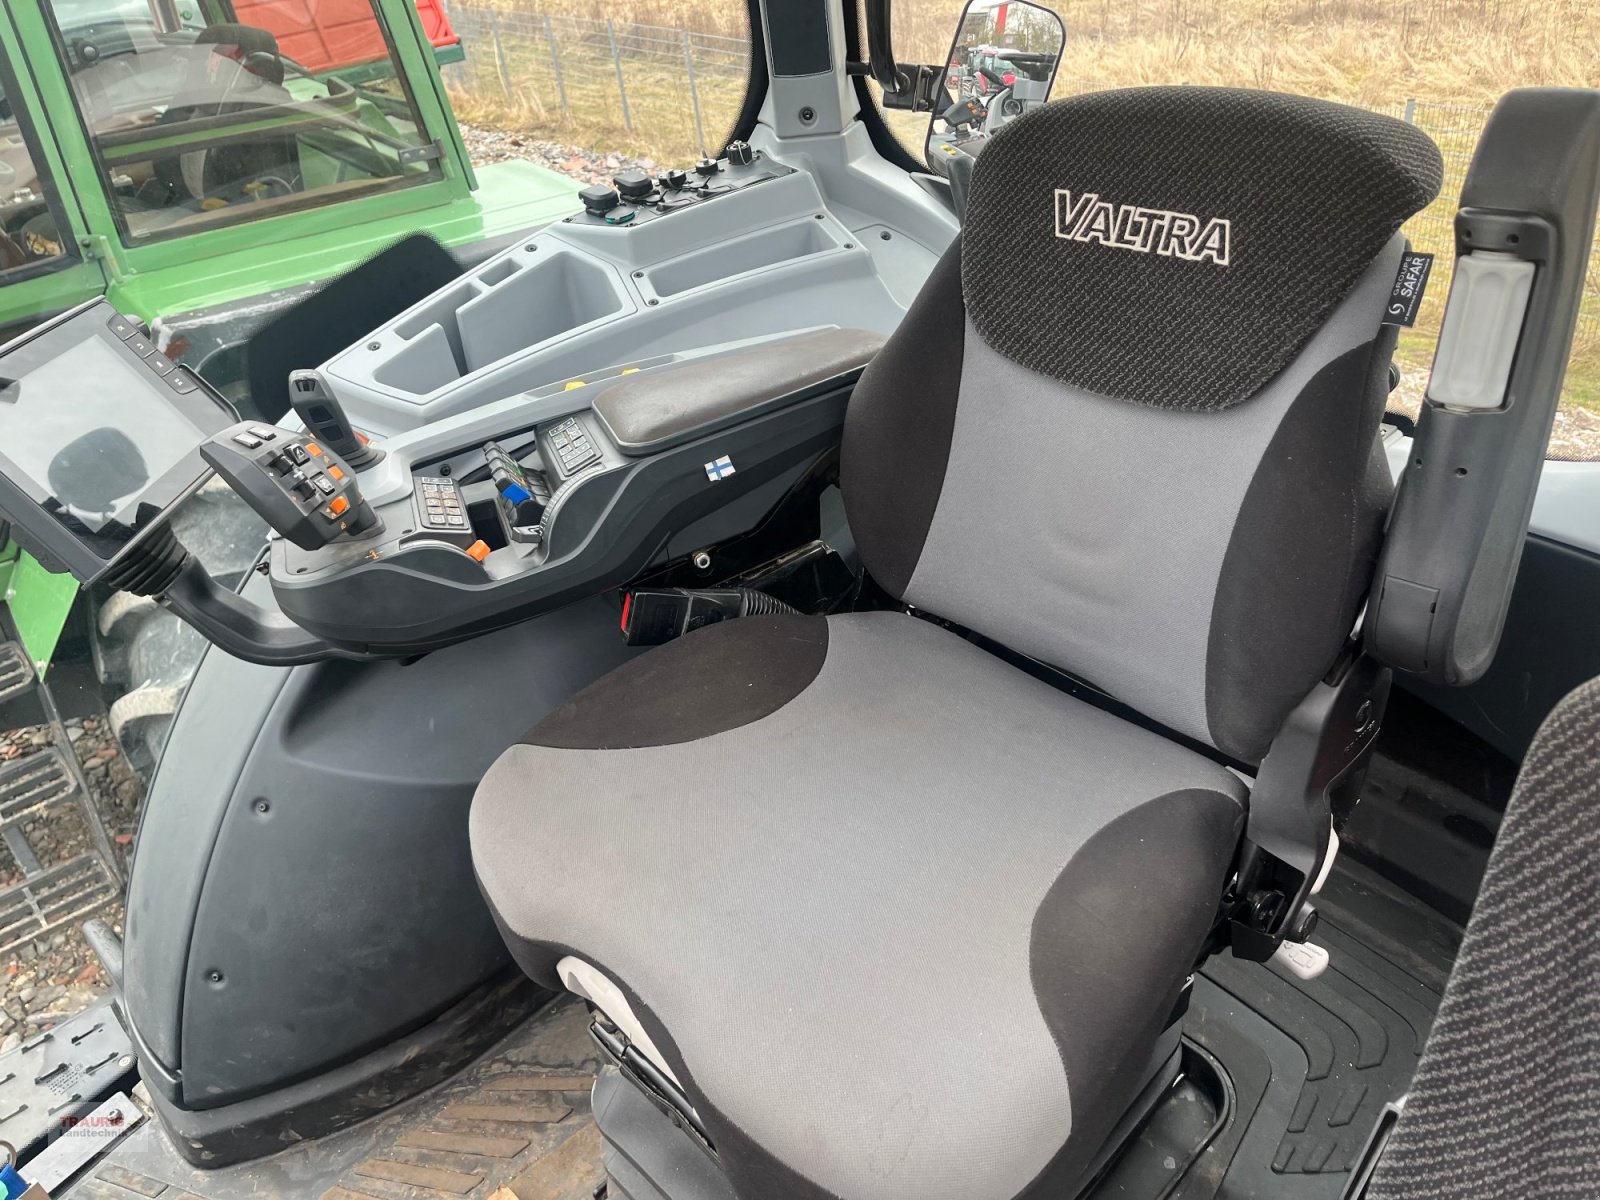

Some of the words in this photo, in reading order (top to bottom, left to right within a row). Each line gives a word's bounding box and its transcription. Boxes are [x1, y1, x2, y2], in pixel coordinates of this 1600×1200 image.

[1055, 189, 1230, 265] VALTRA
[1392, 256, 1413, 296] GROUPE
[1400, 257, 1425, 297] SAFAR
